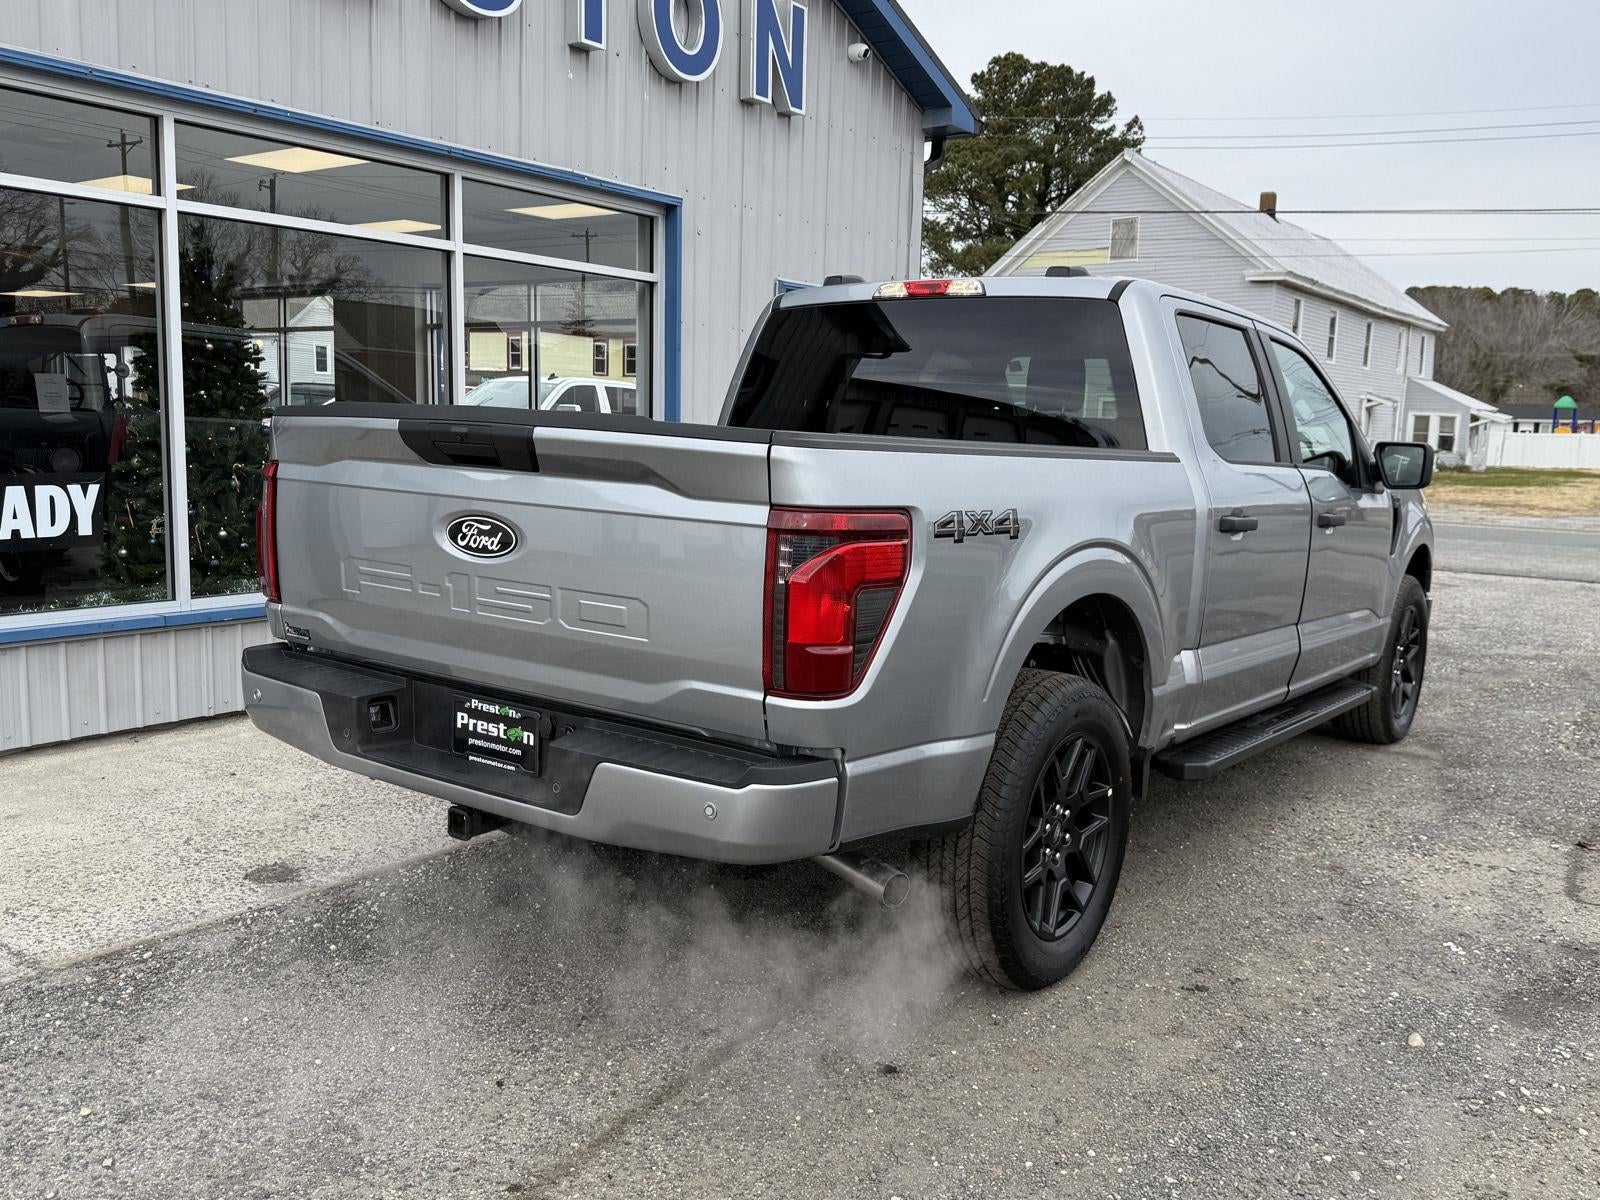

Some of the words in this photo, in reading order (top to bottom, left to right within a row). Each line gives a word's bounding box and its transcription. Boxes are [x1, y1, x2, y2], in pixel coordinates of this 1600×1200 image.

[457, 521, 503, 551] Ford
[340, 555, 649, 642] F-150
[471, 698, 516, 718] Preston
[456, 711, 535, 746] Preston
[468, 738, 522, 757] prestonmotor.com
[468, 755, 516, 772] prestonmotor.com
